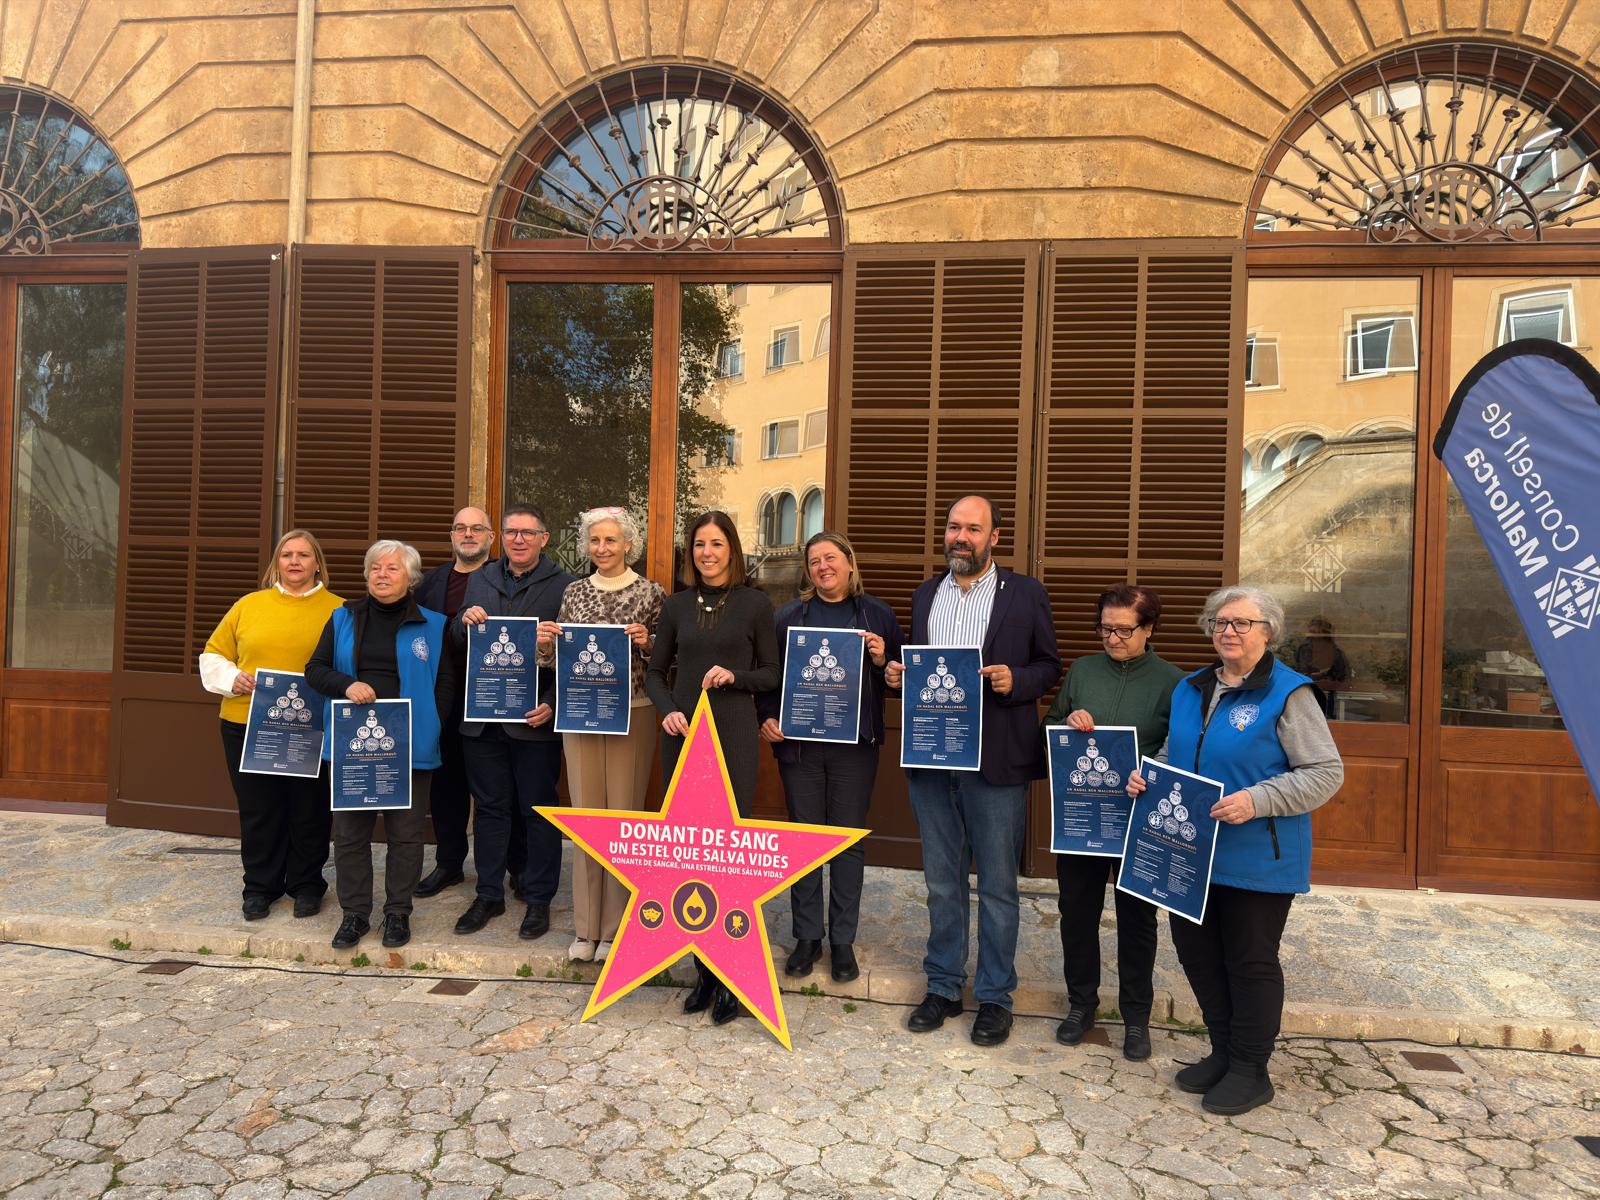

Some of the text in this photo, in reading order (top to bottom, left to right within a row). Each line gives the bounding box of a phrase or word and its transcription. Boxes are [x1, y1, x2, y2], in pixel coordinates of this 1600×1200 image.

[620, 821, 779, 852] DONANT DE SANG
[609, 841, 789, 869] UN ESTEL QUE SALVA VIDES
[611, 857, 785, 879] DONANTE DE SANGRE, UNA ESTRELLA QUE SALVA VIDAS.
